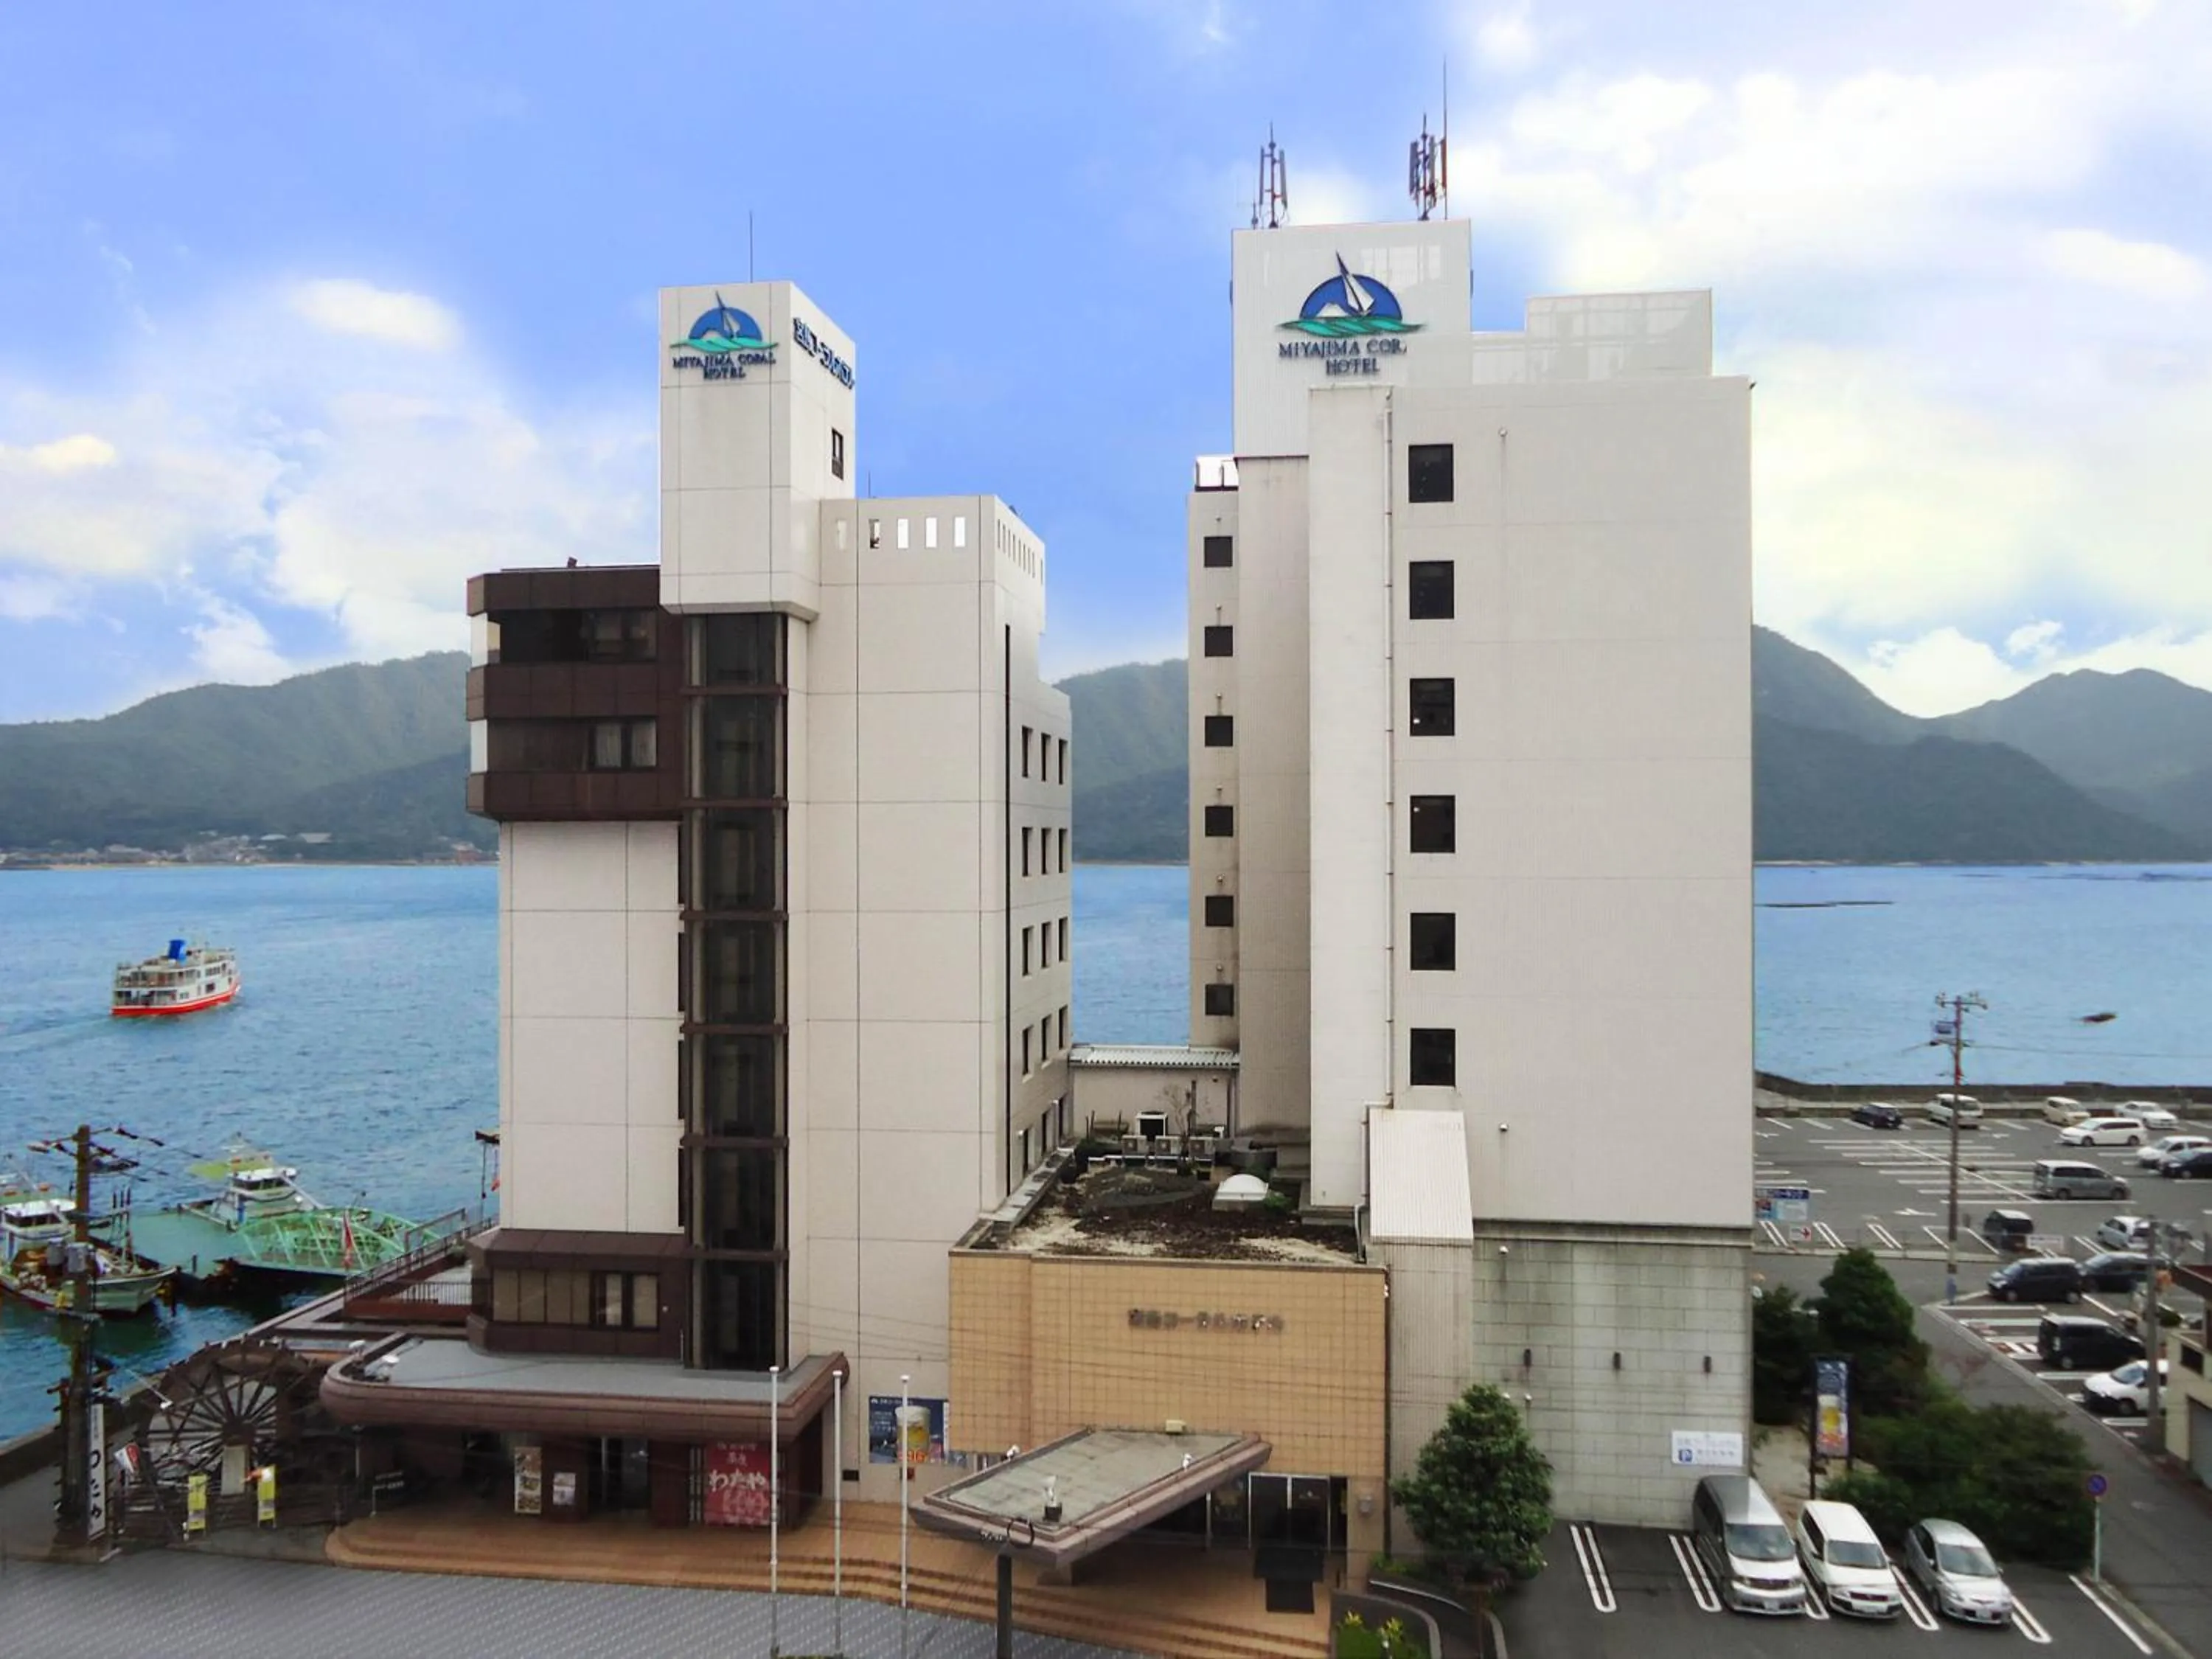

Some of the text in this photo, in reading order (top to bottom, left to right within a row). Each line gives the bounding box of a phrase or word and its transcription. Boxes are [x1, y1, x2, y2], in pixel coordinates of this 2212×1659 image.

[1279, 339, 1360, 359] MIYAJIMA
[703, 366, 746, 380] HOTEL
[1326, 358, 1380, 375] HOTEL
[709, 1468, 767, 1493] わたや
